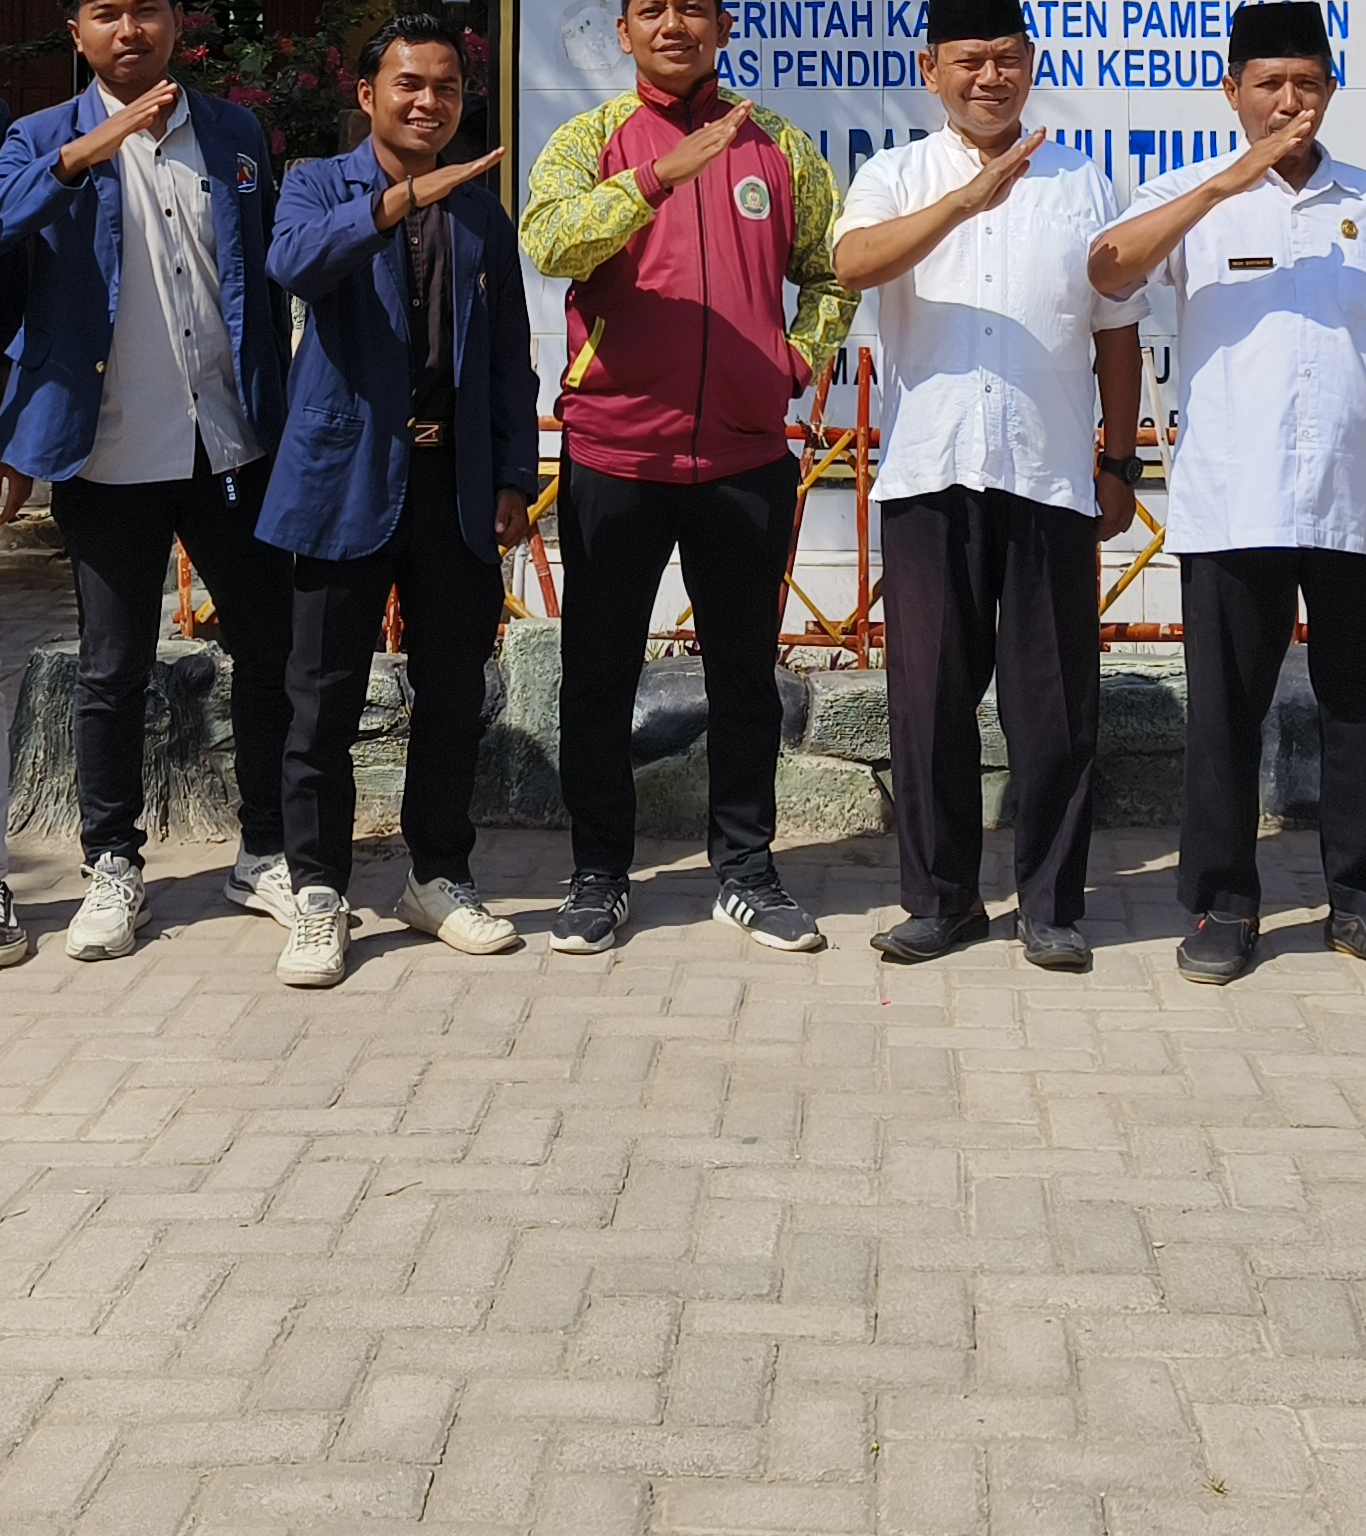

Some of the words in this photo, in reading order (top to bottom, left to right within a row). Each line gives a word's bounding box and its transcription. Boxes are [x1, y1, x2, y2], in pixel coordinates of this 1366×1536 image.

[722, 0, 873, 39] ERINTAH
[888, 0, 1107, 39] KAATEN
[1123, 0, 1349, 40] PAMEKN
[774, 50, 926, 87] PENDIDI
